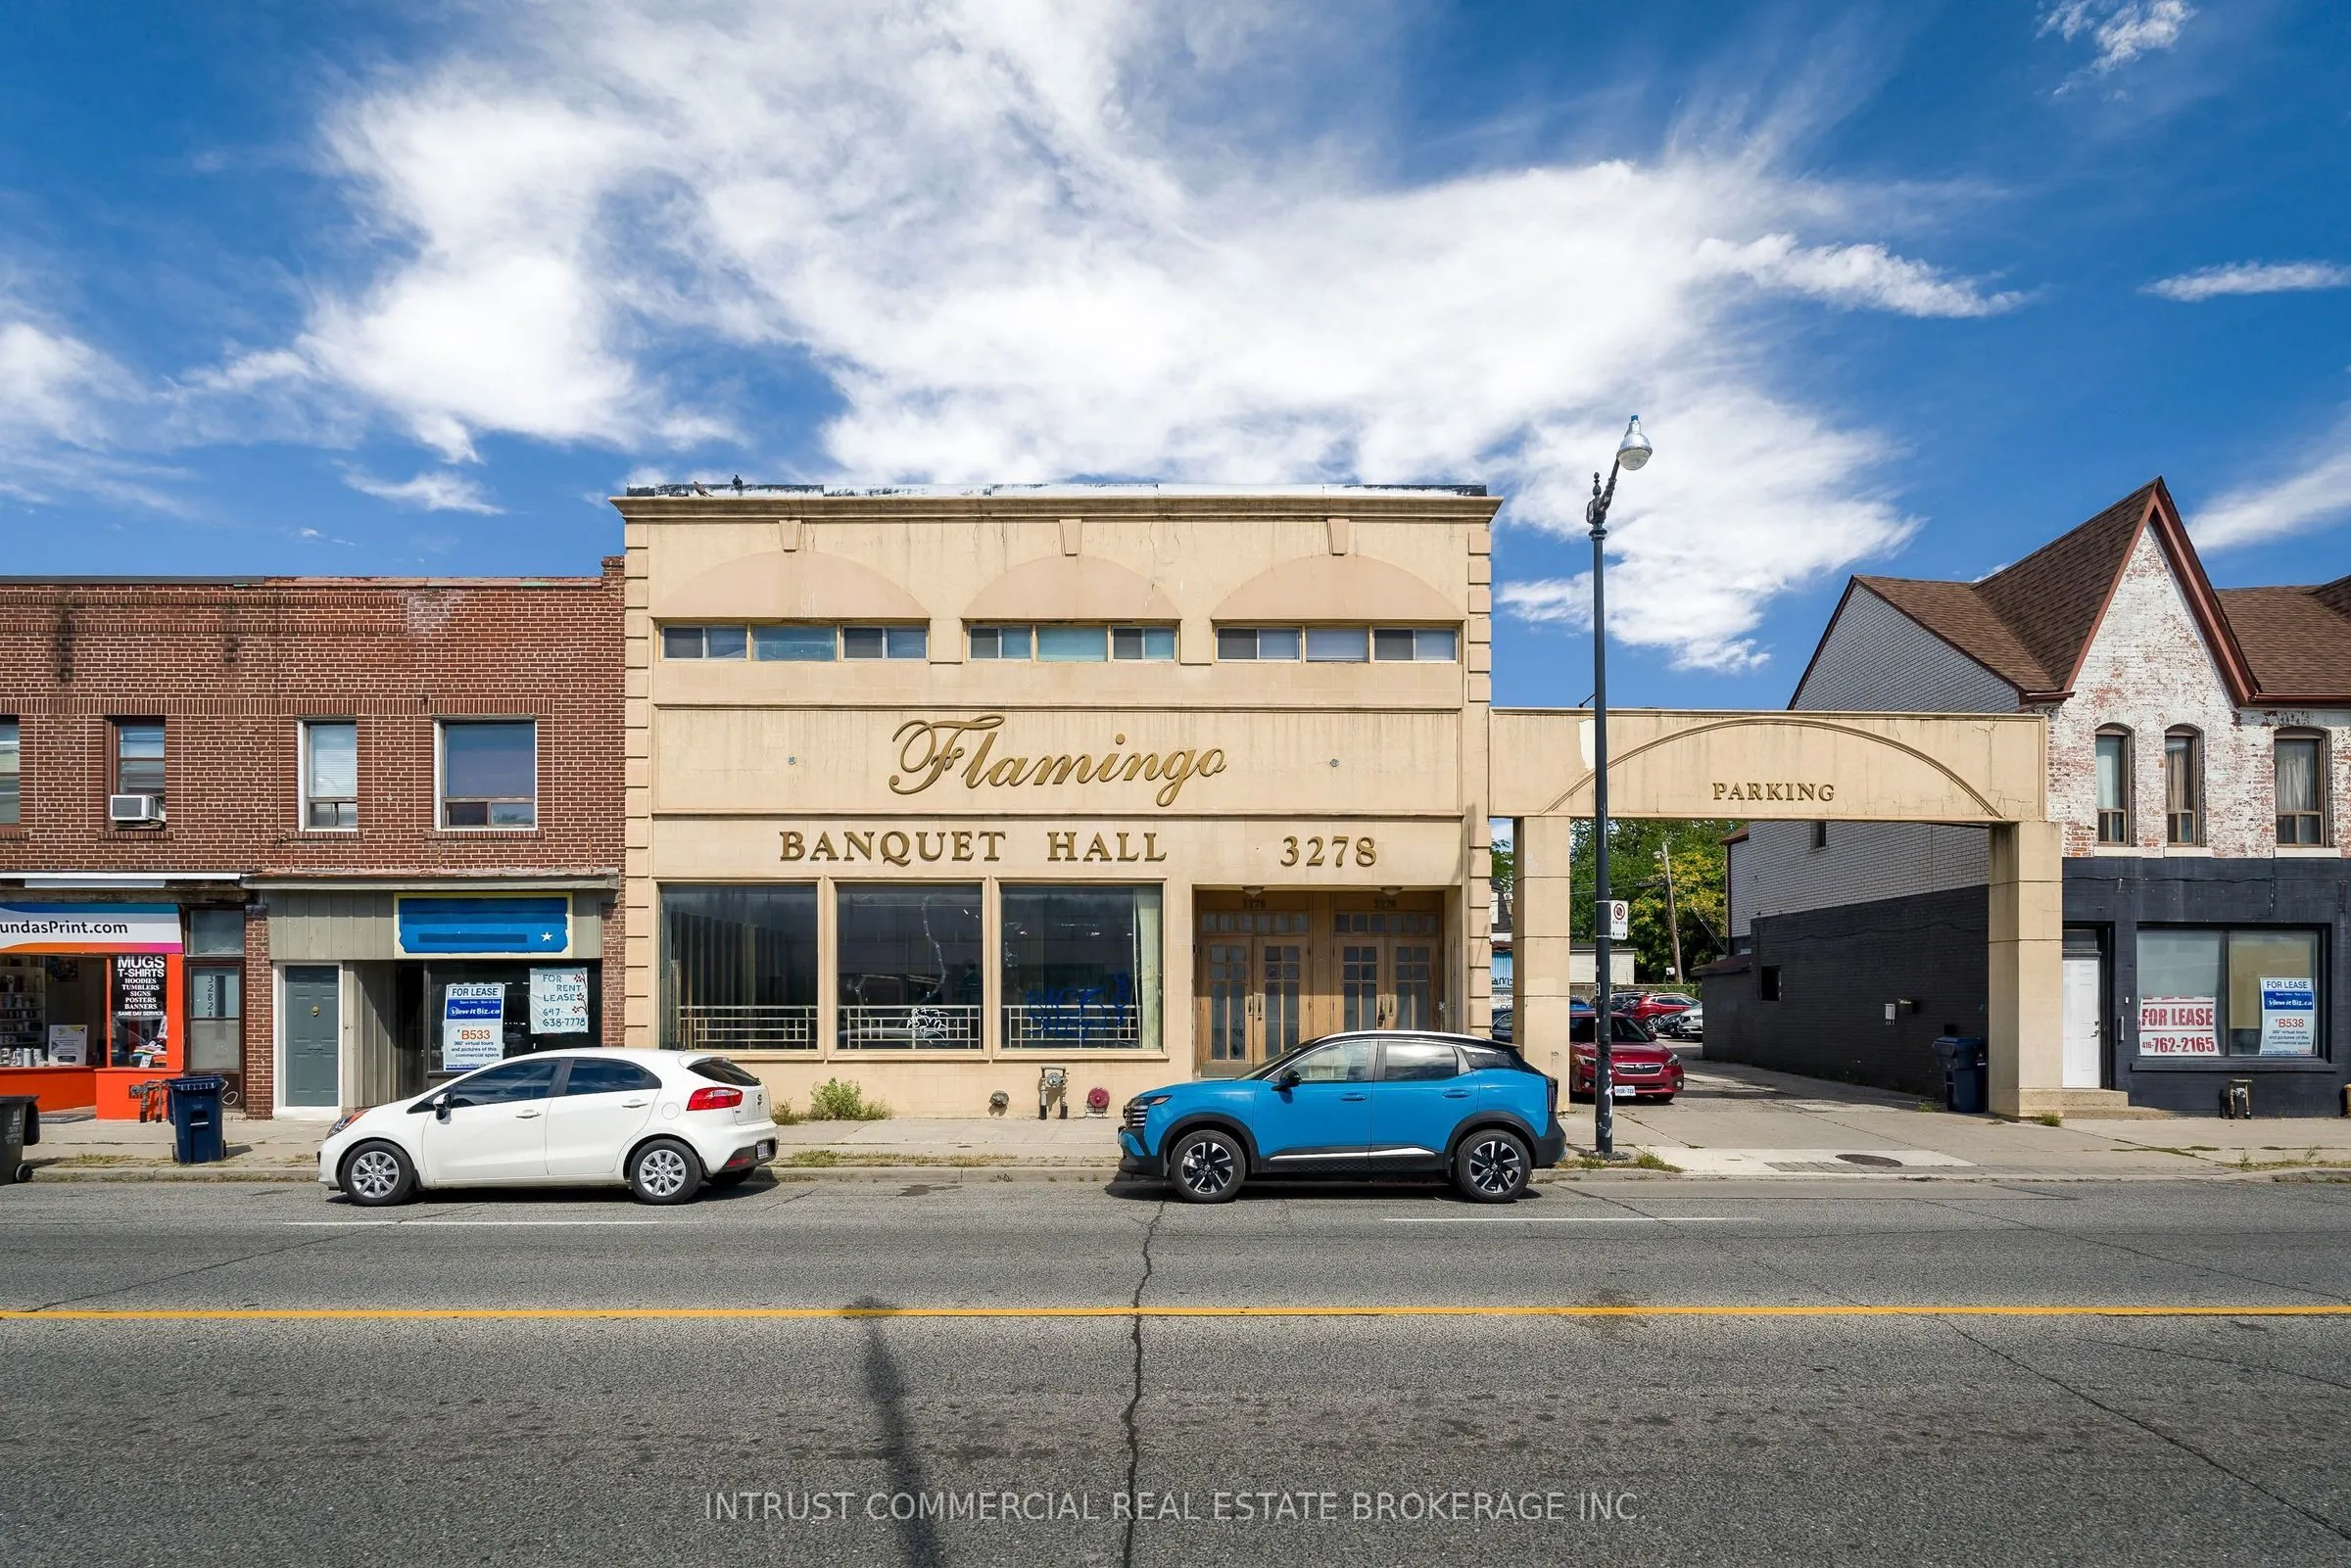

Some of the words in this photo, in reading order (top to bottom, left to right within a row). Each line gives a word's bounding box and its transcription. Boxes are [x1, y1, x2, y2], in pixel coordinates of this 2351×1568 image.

[888, 713, 1227, 808] Flamingo
[1712, 782, 1835, 801] PARKING
[780, 831, 1006, 867] BANQUET
[1047, 831, 1168, 863] HALL
[1279, 835, 1377, 868] 3278
[118, 956, 165, 968] MUGS
[118, 969, 165, 977] T-SHIRTS
[543, 974, 562, 982] FOR
[2266, 980, 2282, 989] FOR
[2283, 980, 2308, 989] LEASE
[452, 987, 469, 997] FOR
[470, 987, 499, 997] LEASE
[543, 993, 576, 1002] LEASE
[2141, 1008, 2168, 1026] FOR
[2171, 1008, 2214, 1026] LEASE
